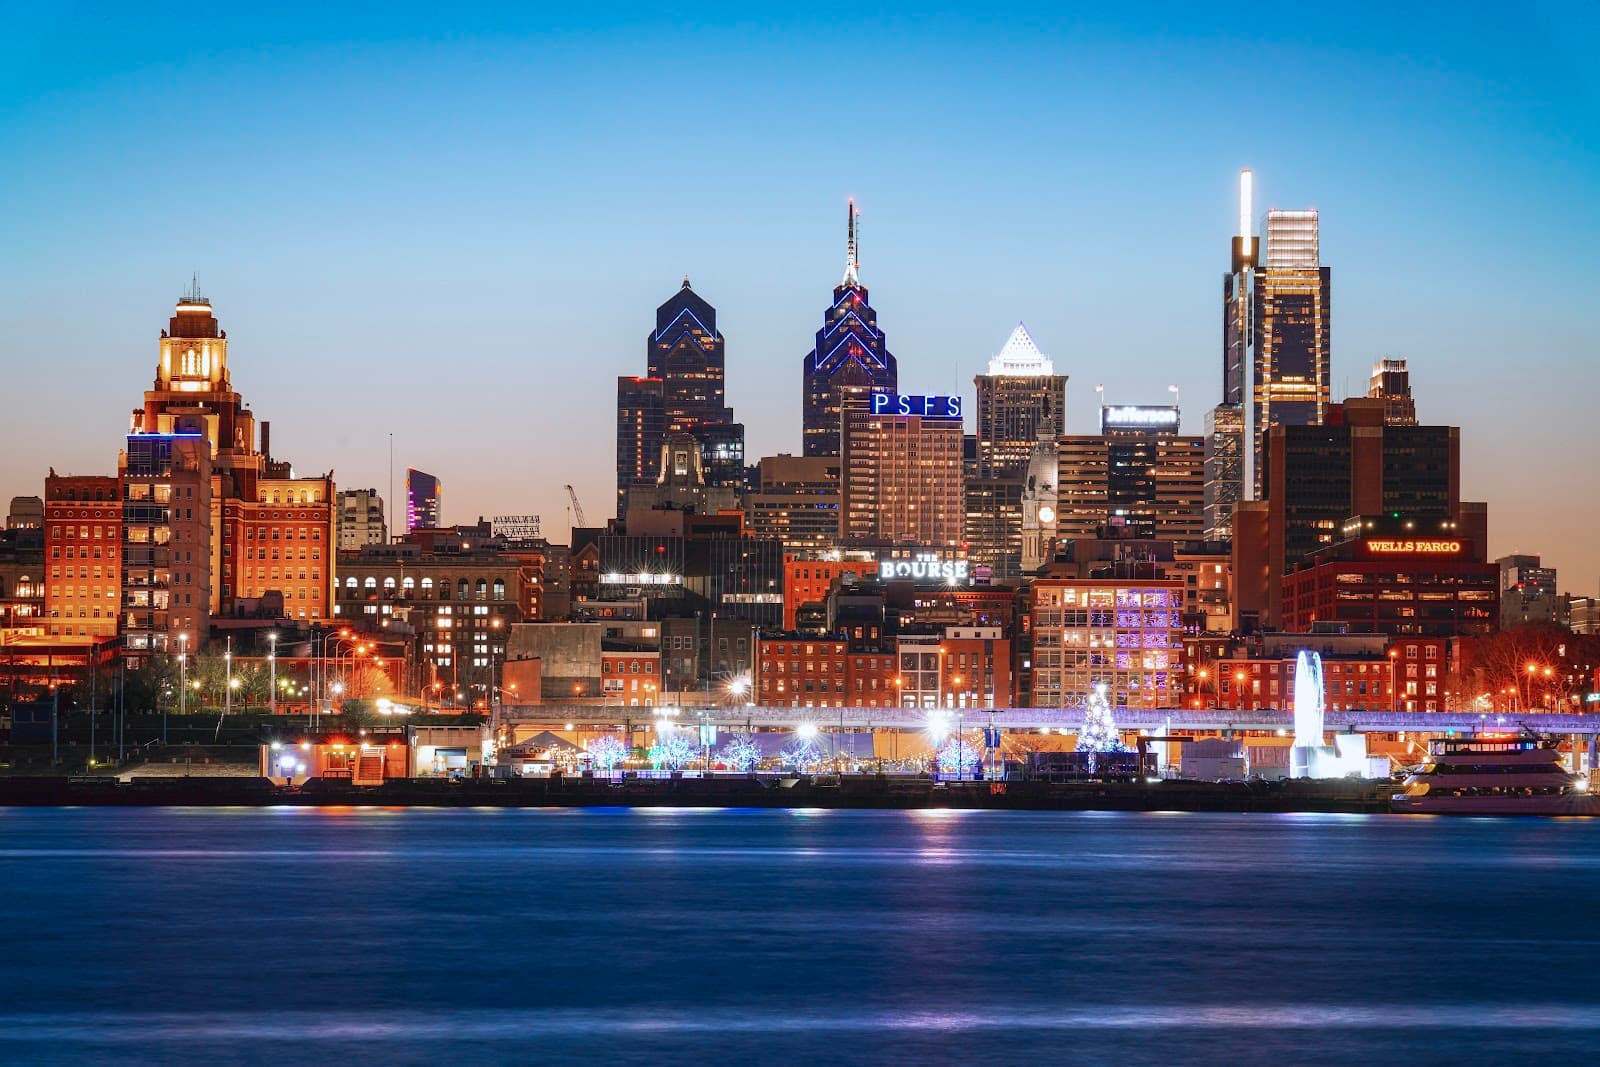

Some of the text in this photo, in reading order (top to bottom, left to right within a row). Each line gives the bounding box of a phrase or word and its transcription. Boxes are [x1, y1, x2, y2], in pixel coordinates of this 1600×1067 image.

[1368, 541, 1460, 552] WELLS FARGO
[916, 554, 938, 562] THE
[881, 562, 968, 578] BOURSE
